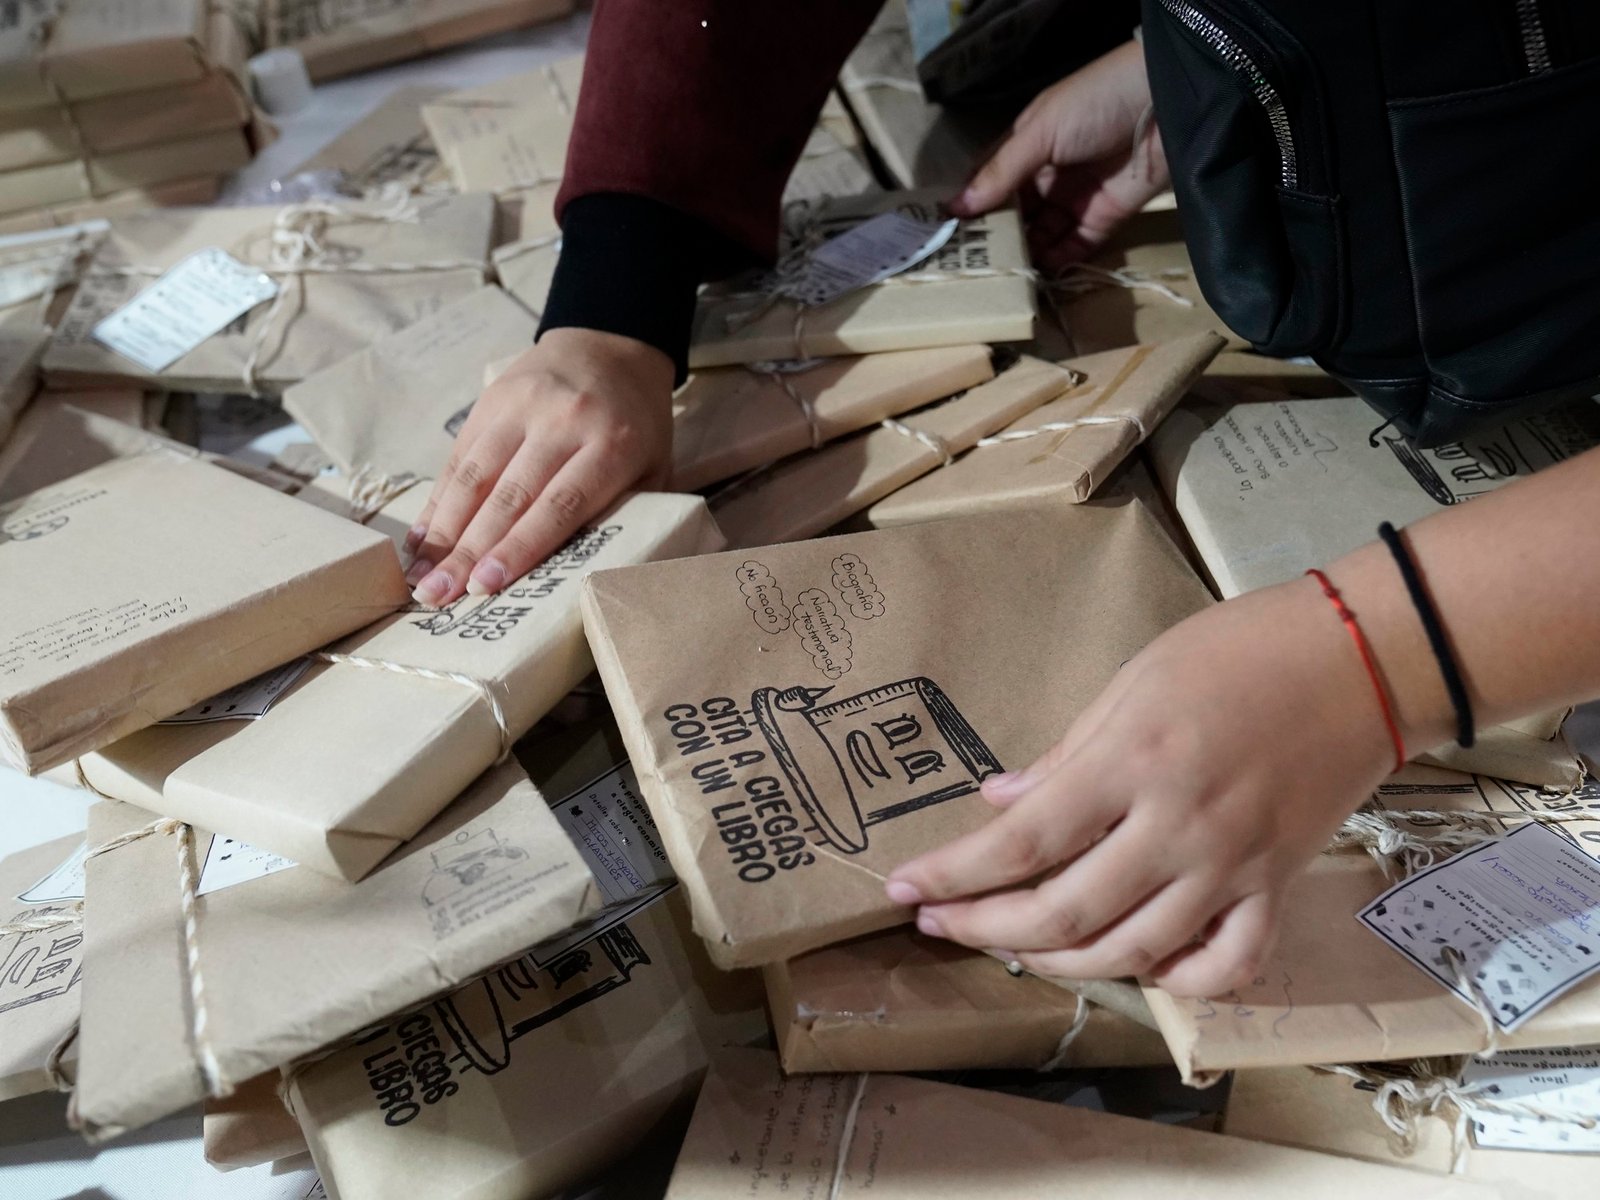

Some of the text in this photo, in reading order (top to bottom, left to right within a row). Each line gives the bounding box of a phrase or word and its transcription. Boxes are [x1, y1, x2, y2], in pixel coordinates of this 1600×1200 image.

[482, 524, 623, 641] CON UN LIBRO
[746, 568, 759, 582] No
[840, 562, 873, 612] Biografía
[459, 606, 512, 639] CITA
[801, 611, 841, 672] testimonial
[810, 597, 840, 644] Narrativa
[664, 704, 776, 882] CON UN LIBRO
[701, 697, 815, 870] CITA A CIEGAS
[589, 793, 609, 818] Detalles
[609, 819, 623, 835] sobre
[616, 799, 638, 824] ciegas
[637, 824, 667, 864] conmigo.
[1436, 884, 1552, 972] Te propongo una cita
[1507, 925, 1543, 953] ciegas
[397, 1014, 459, 1104] CIEGAS
[1532, 1060, 1599, 1070] propongo
[1549, 1047, 1591, 1057] ciegas
[363, 1046, 420, 1127] LIBRO
